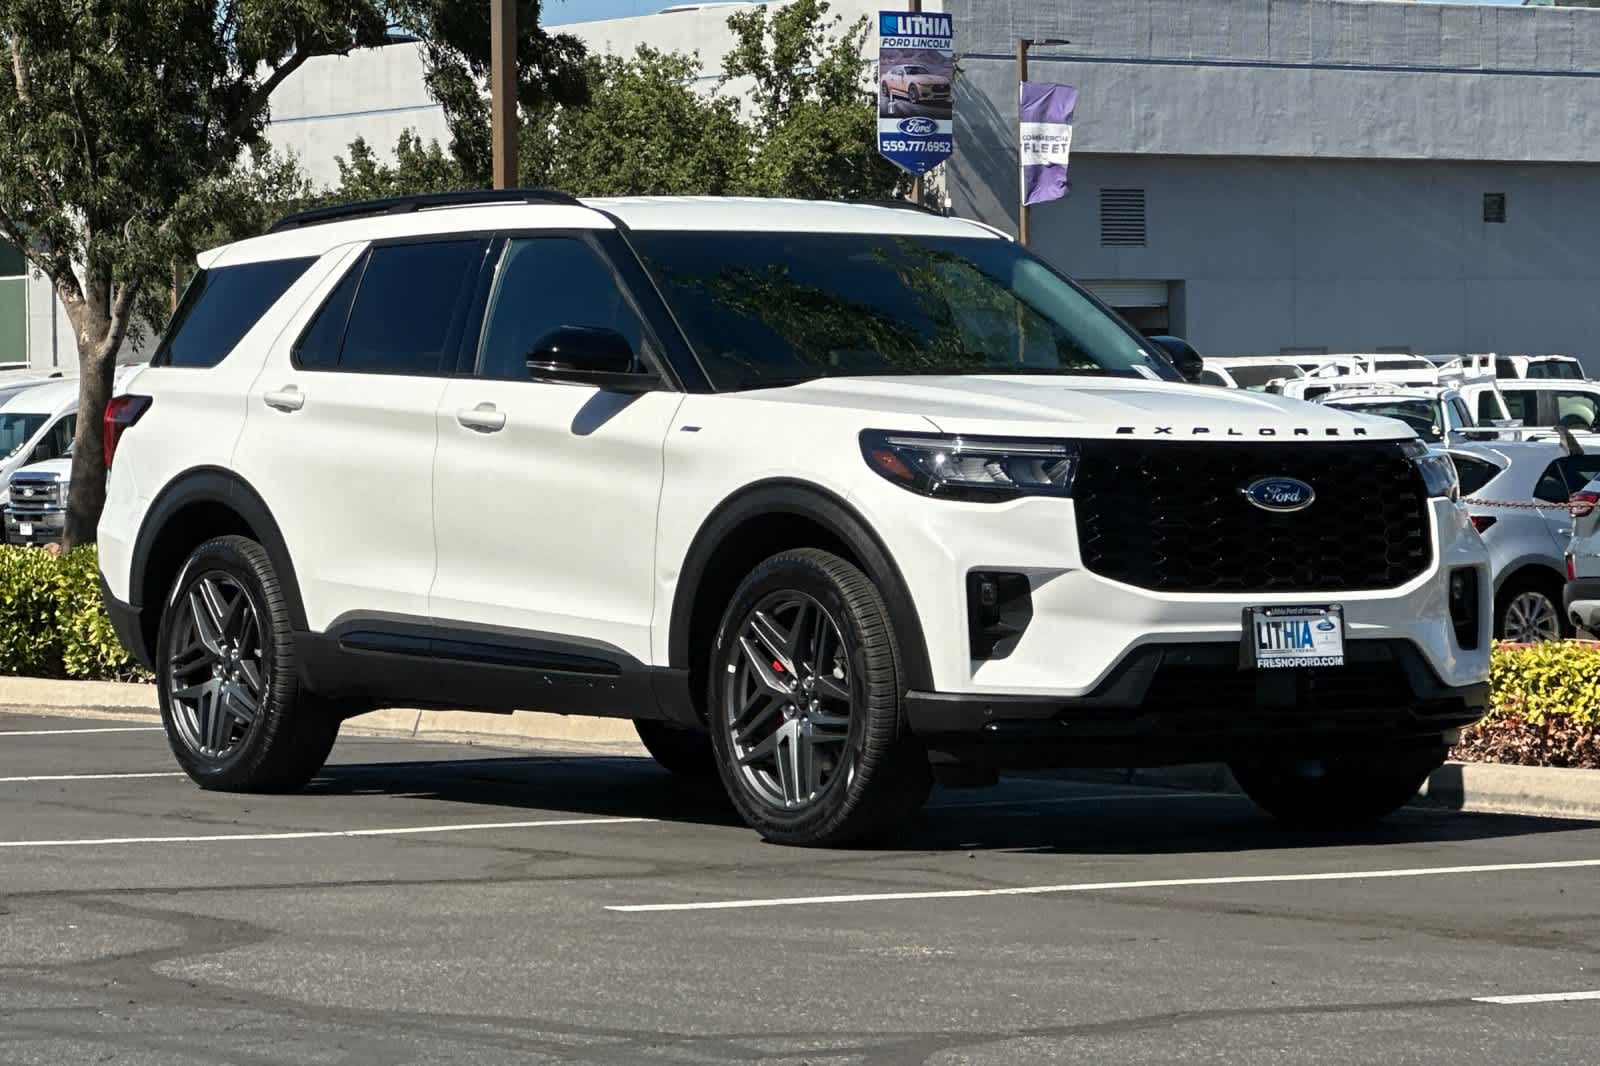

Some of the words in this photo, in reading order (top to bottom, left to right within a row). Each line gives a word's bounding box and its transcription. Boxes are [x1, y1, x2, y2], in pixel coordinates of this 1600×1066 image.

[897, 16, 951, 36] LITHIA
[882, 38, 911, 47] FORD
[911, 38, 950, 48] LINCOLN
[882, 140, 951, 152] 559.777.6952
[1023, 143, 1068, 154] FLEET
[1115, 426, 1368, 437] EXPLORER
[1264, 484, 1301, 503] Ford
[1256, 619, 1314, 650] LITHIA
[1257, 656, 1344, 668] FRESNOFORD.COM
